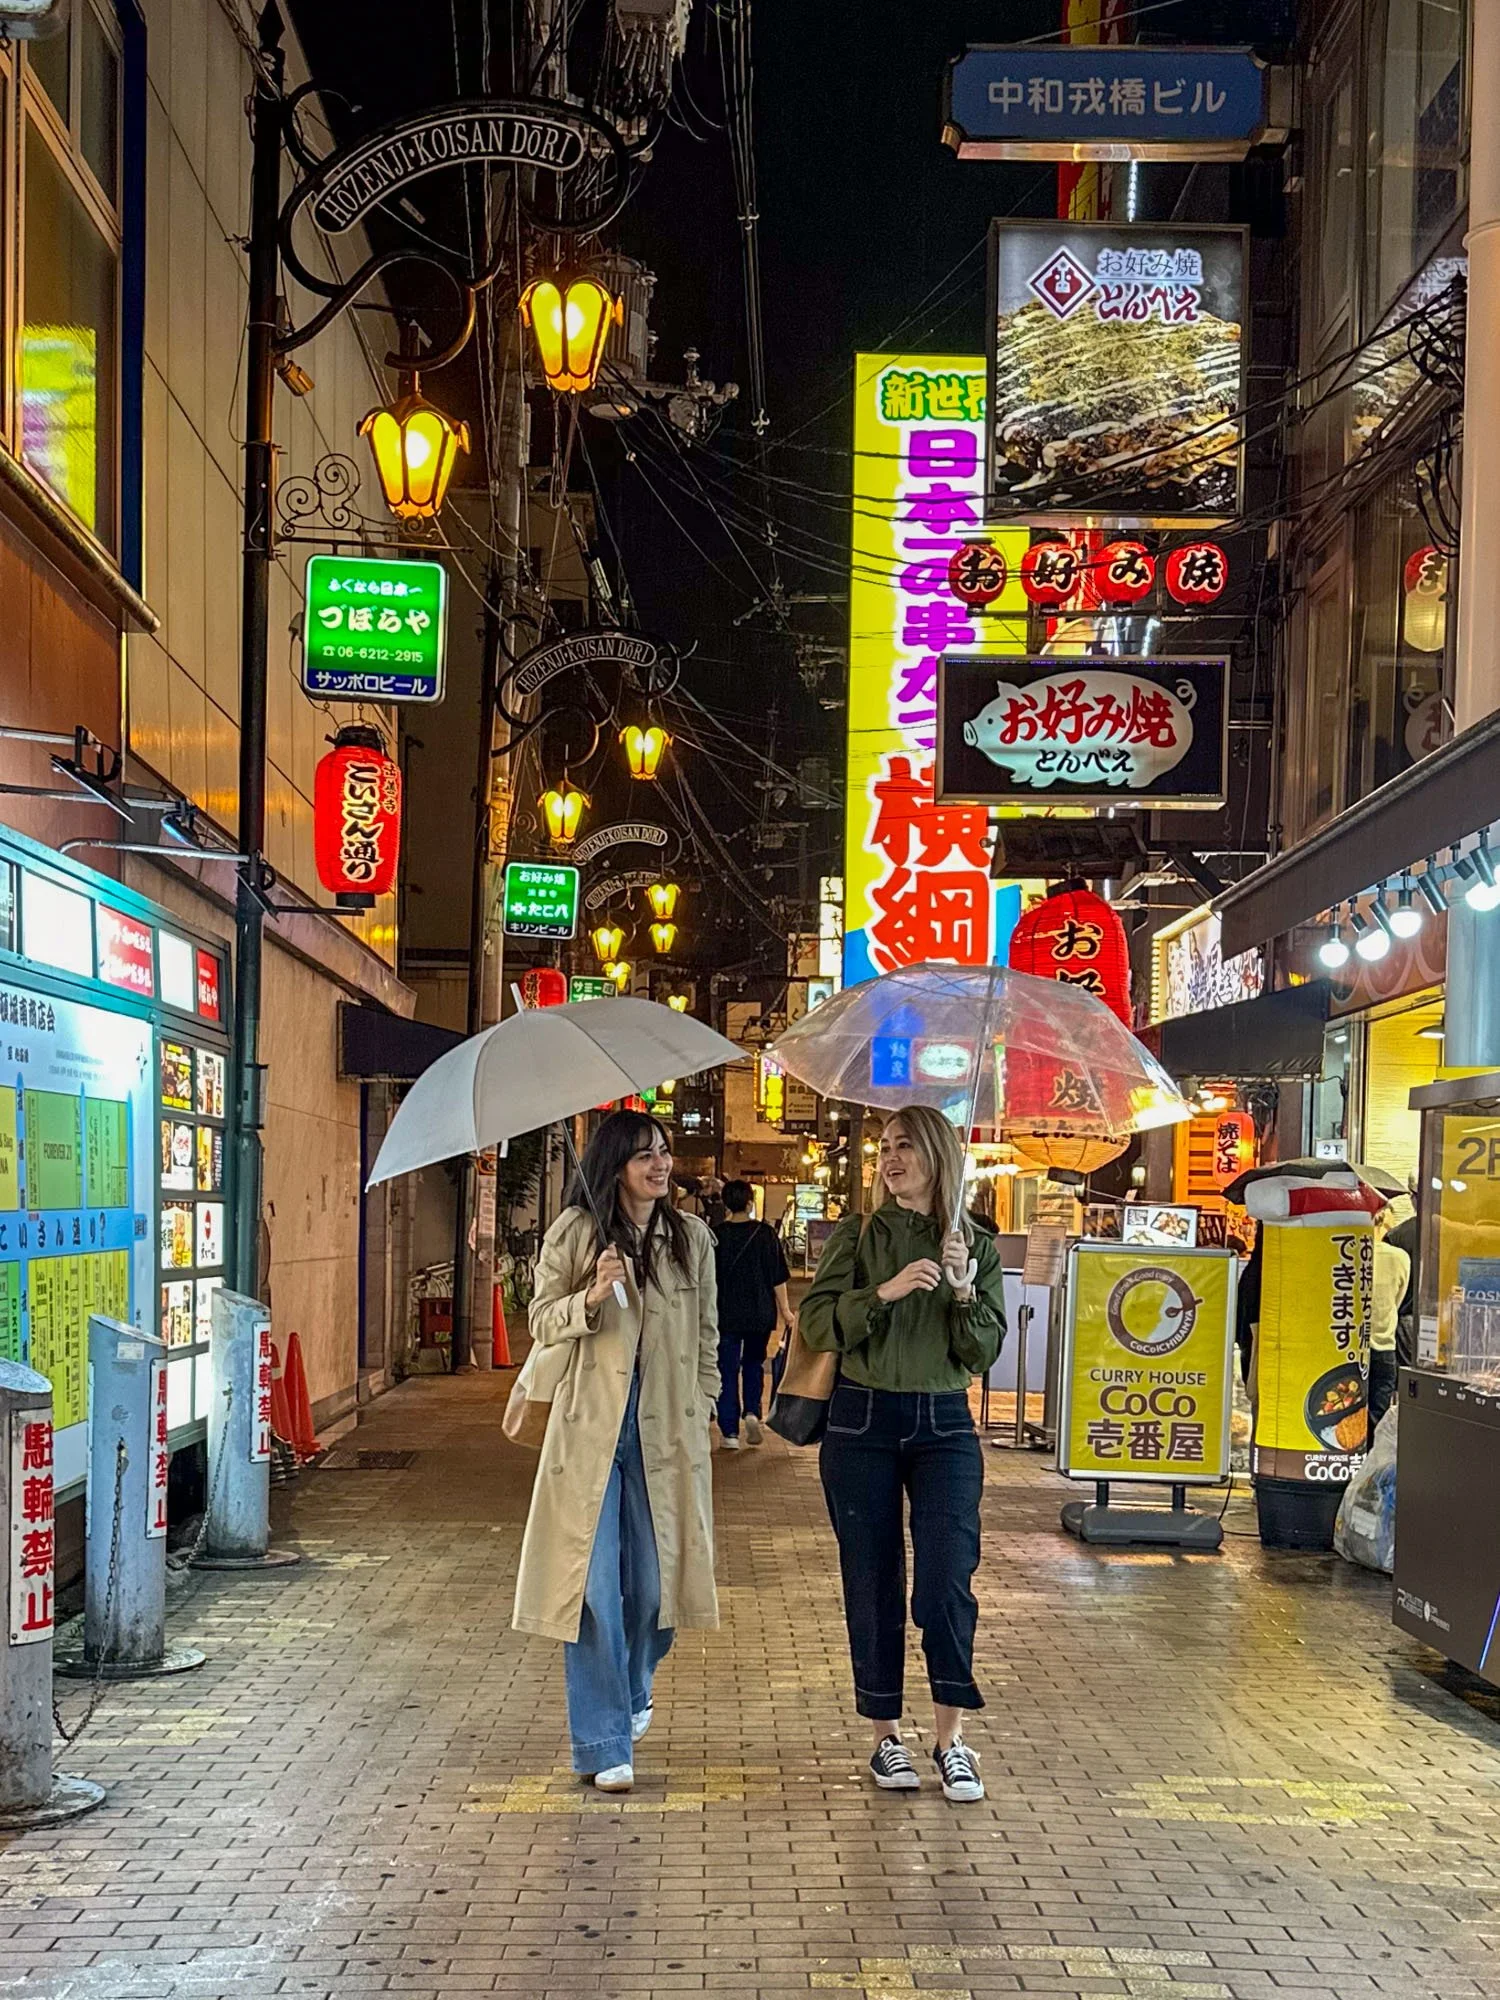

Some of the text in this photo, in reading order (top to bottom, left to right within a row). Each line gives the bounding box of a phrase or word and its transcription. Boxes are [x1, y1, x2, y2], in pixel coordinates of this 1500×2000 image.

[988, 76, 1227, 116] 中和戎橋ビル
[1100, 251, 1199, 277] お好み焼
[1098, 284, 1199, 321] とんべえ
[317, 603, 431, 636] づぼらや
[337, 646, 424, 663] 06-6212-2915
[315, 671, 428, 695] サッポロビール
[999, 679, 1178, 748] お好み焼
[1035, 749, 1135, 773] とんべえ
[343, 762, 384, 882] こいさん通り
[870, 756, 992, 972] 横綱
[43, 1143, 65, 1160] FOREVER
[1216, 1122, 1240, 1174] 焼そば
[1330, 1234, 1357, 1362] できます。
[1090, 1368, 1207, 1386] CURRY HOUSE
[1099, 1385, 1197, 1418] CoCo
[1087, 1418, 1204, 1462] 壱番屋
[1304, 1462, 1349, 1481] CoCo
[21, 1419, 54, 1632] 駐輪禁止
